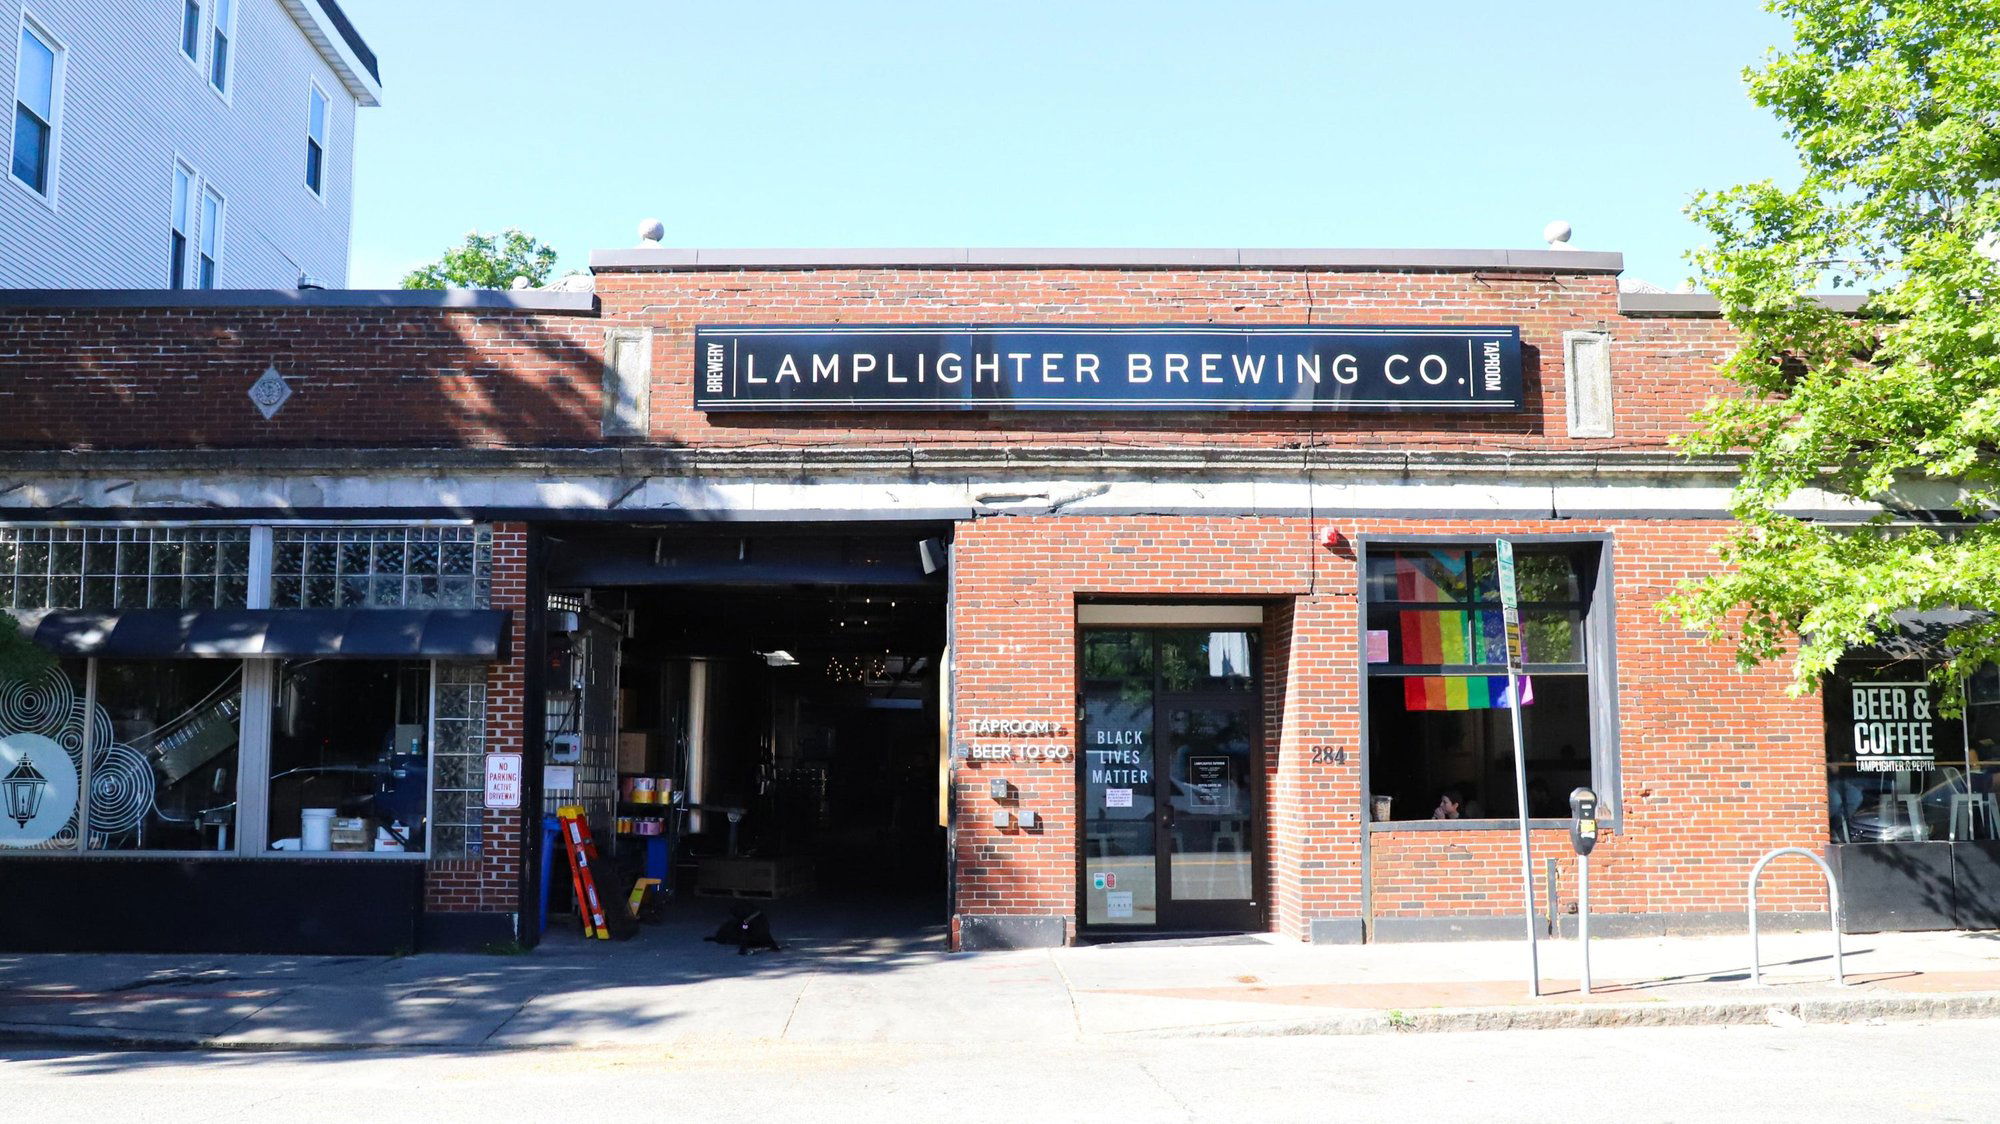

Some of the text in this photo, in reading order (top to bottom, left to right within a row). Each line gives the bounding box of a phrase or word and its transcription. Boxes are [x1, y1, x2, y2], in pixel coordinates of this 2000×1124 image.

[706, 343, 724, 393] BREWERY
[747, 353, 1465, 385] LAMPLIGHTER BREWING CO.
[1483, 340, 1502, 391] TAPROOM
[1852, 688, 1932, 720] BEER &
[969, 719, 1049, 733] TAPROOM
[1097, 730, 1143, 745] BLACK
[1854, 722, 1934, 754] COFFEE
[972, 743, 1069, 759] BEER TO GO
[1100, 750, 1140, 764] LIVES
[1312, 745, 1346, 765] 284
[499, 762, 508, 771] NO
[1856, 760, 1905, 772] LAMPLIGHTER
[1912, 760, 1936, 772] PEPITA
[490, 773, 517, 781] PARKING
[1092, 769, 1148, 784] MATTER
[493, 783, 512, 791] ACTIVE
